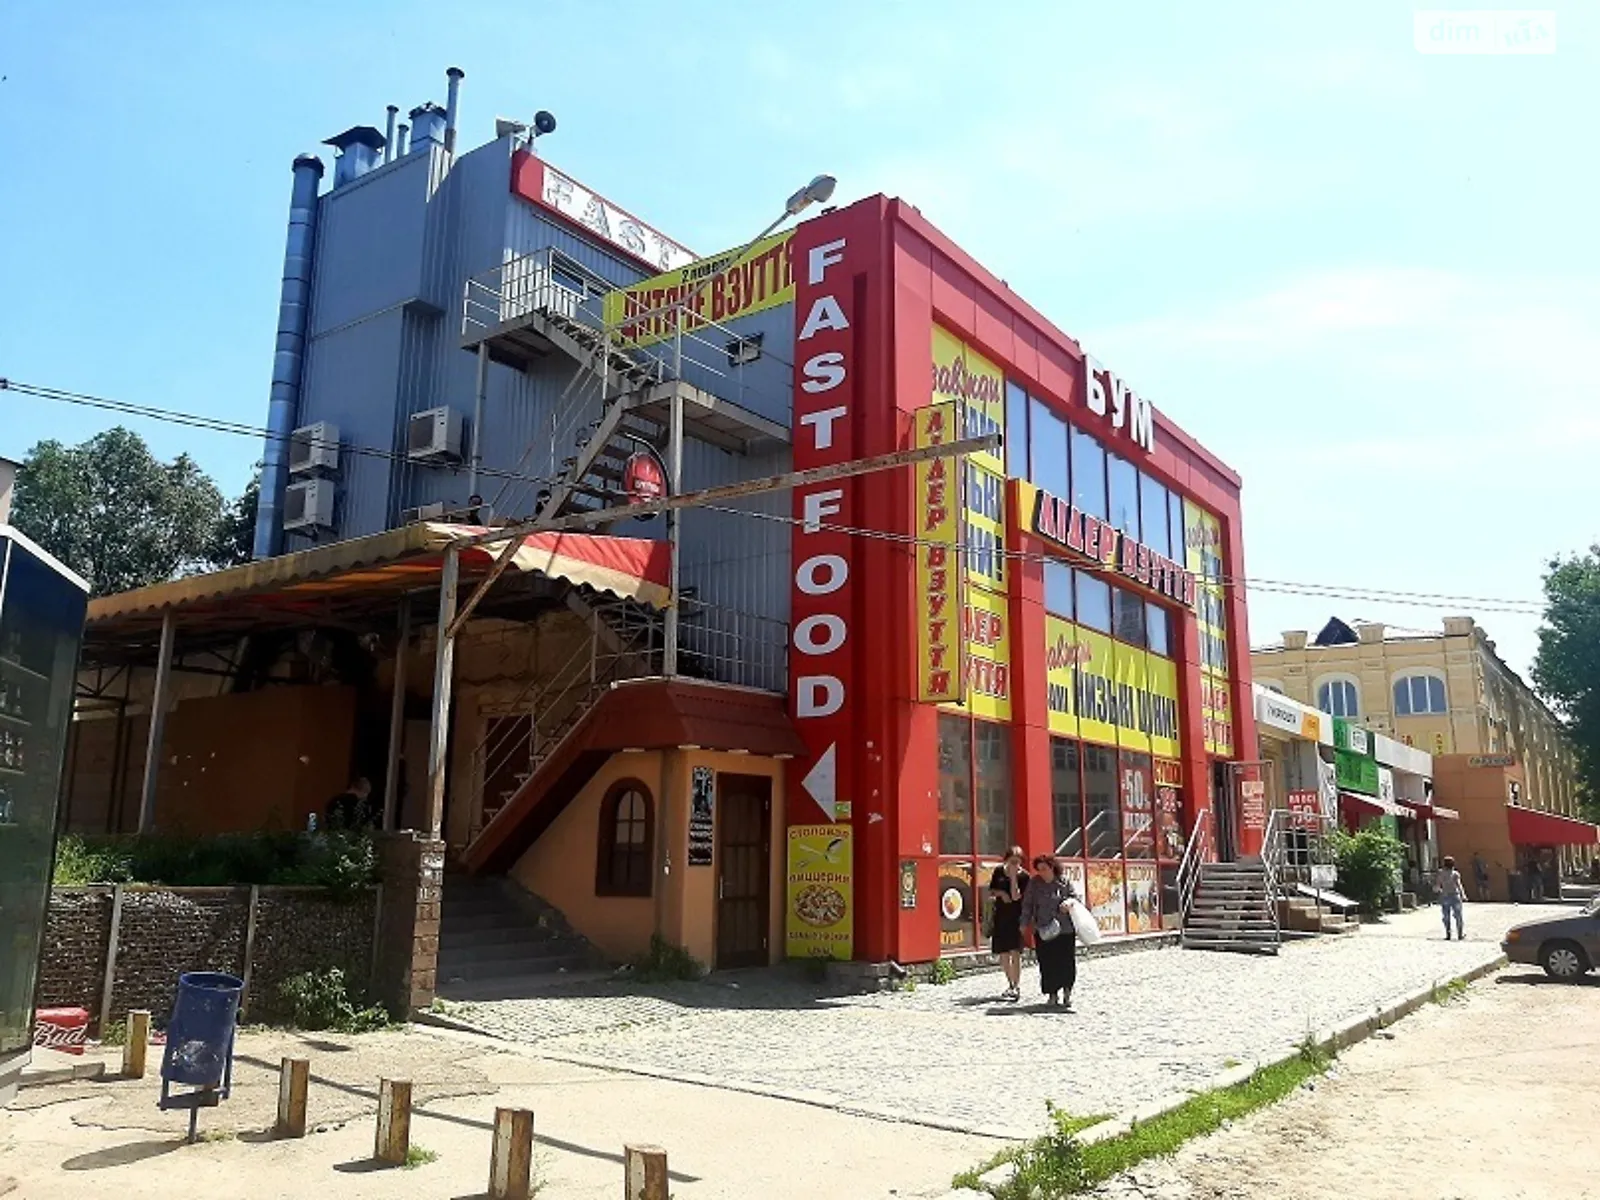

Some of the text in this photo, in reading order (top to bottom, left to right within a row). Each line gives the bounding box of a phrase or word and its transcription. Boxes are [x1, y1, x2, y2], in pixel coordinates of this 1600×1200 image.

[546, 171, 681, 272] FAST
[799, 238, 850, 449] FAST
[1085, 354, 1153, 455] БУМ
[793, 489, 849, 719] FOOD
[1037, 489, 1116, 564] ЛІДЕР
[1120, 530, 1197, 607] ВЗУТТЯ
[925, 544, 950, 696] ВЗУТТЯ
[34, 1021, 88, 1047] Bud
